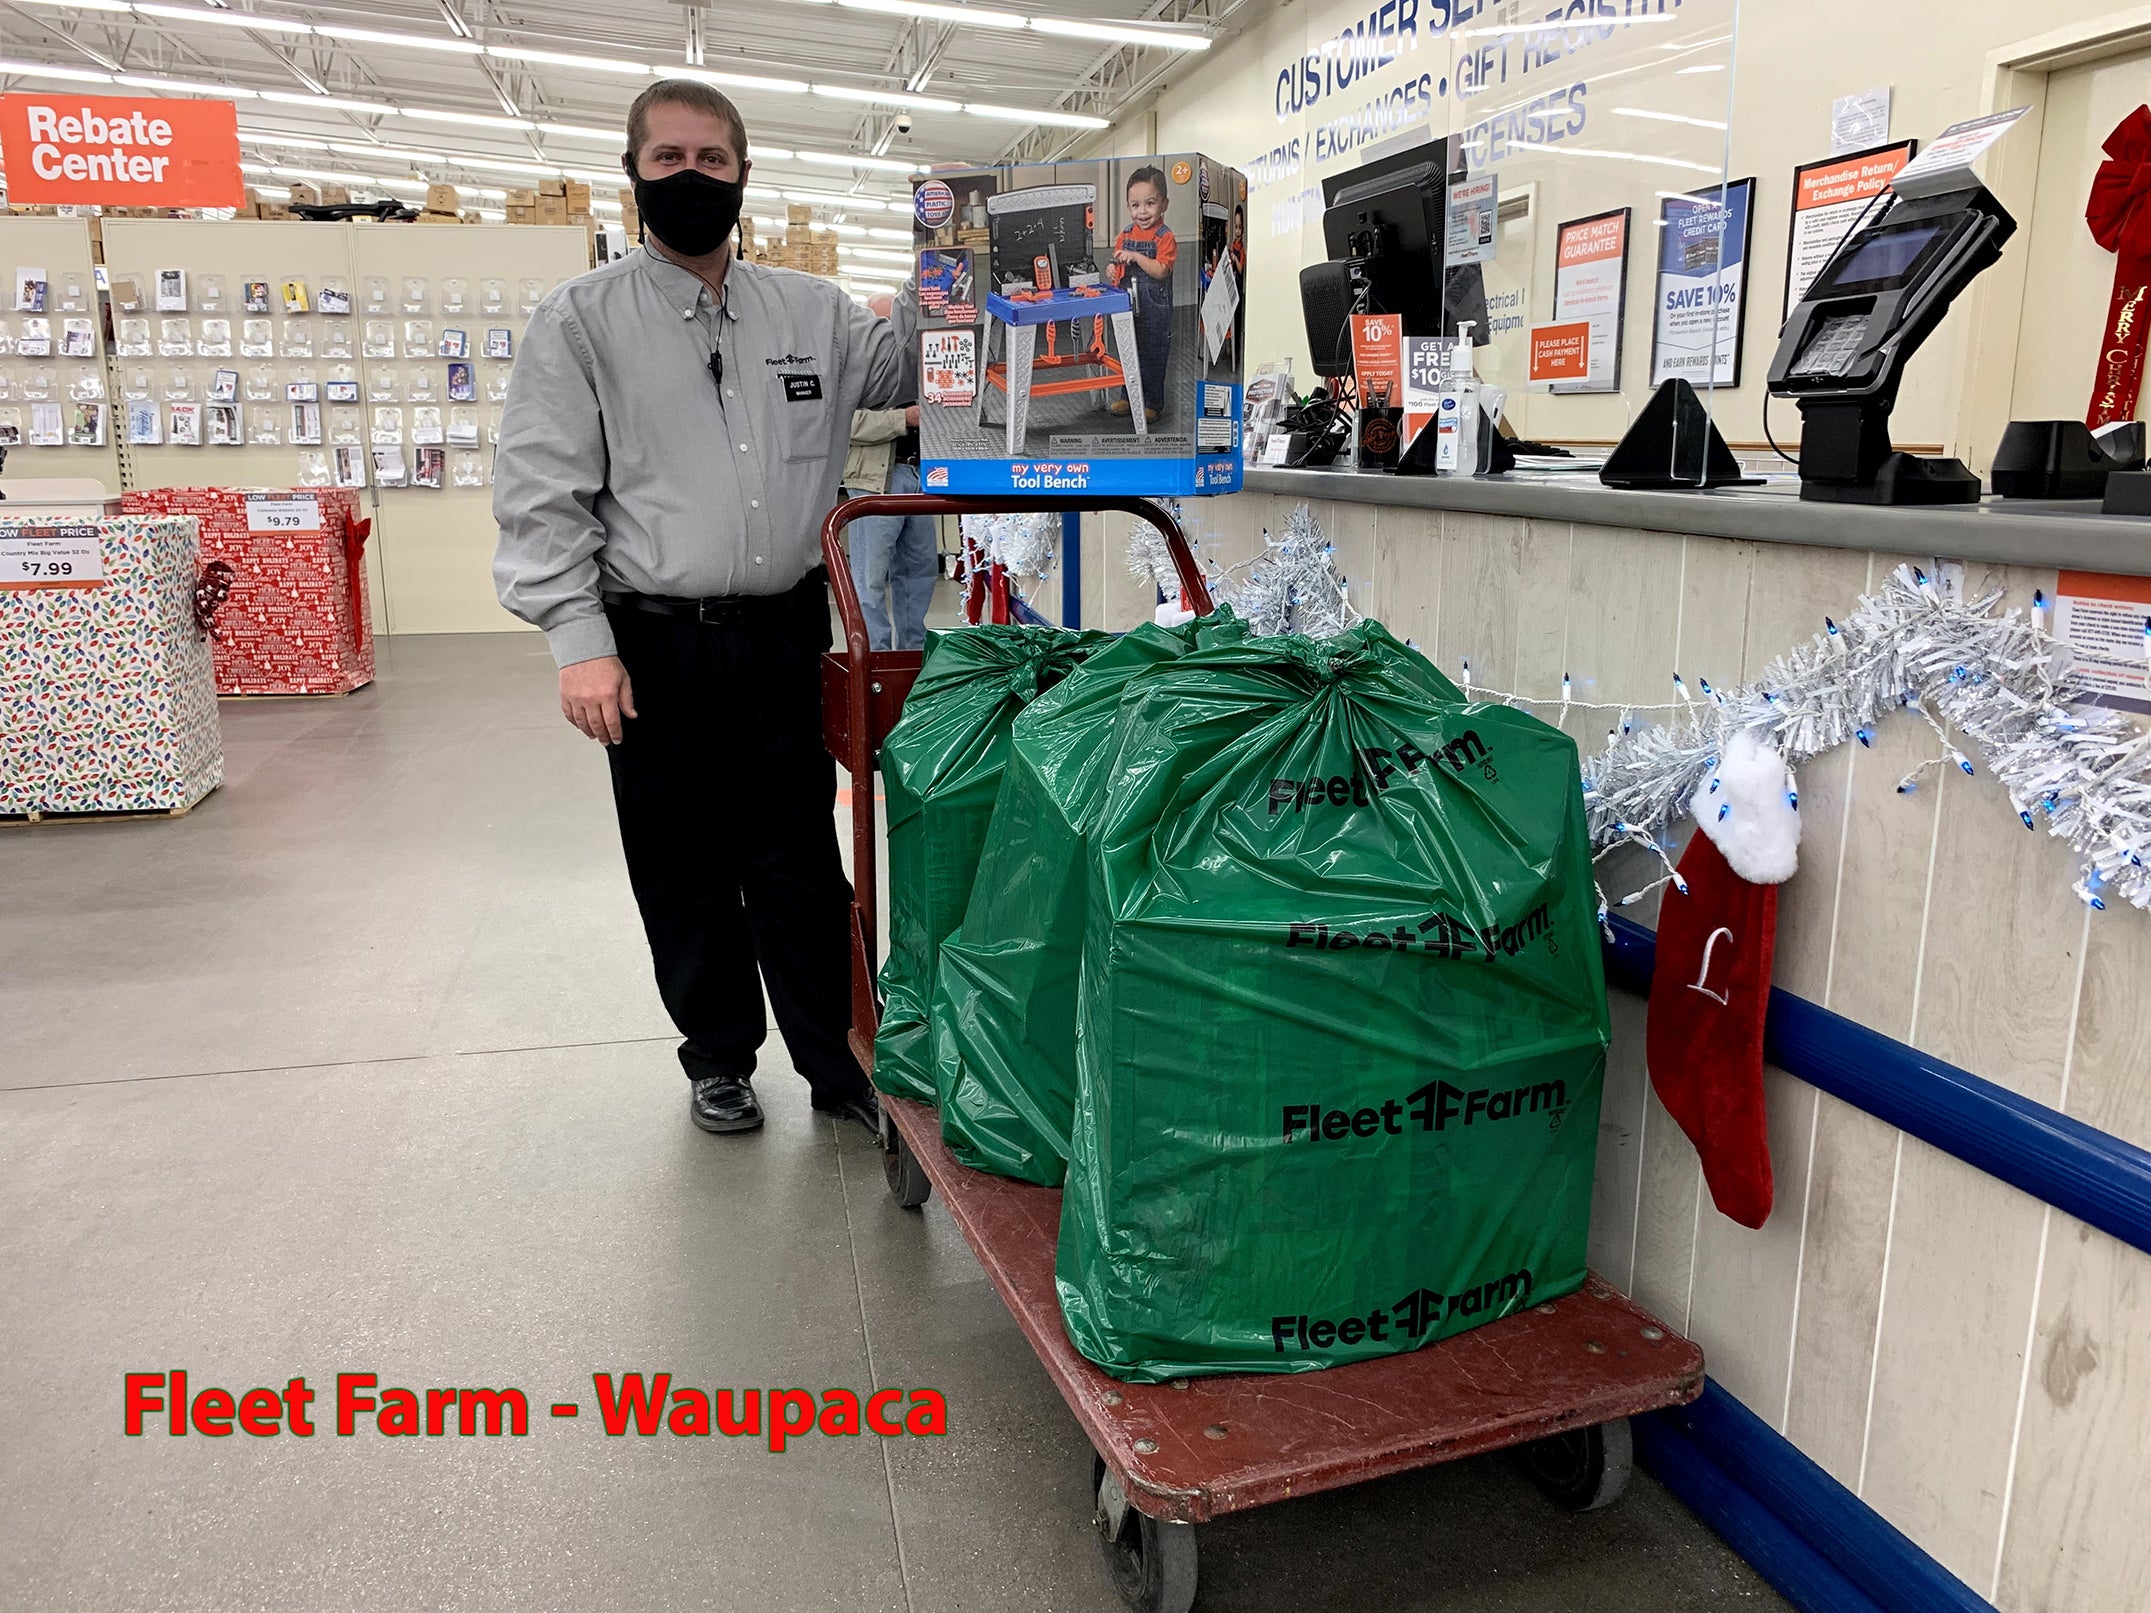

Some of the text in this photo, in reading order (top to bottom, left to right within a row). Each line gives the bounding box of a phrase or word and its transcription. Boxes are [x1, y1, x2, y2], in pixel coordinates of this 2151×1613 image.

[1275, 0, 1419, 124] CUSTOMER
[1455, 32, 1515, 101] GIFT
[27, 106, 172, 146] Rebate
[1240, 137, 1300, 193] ETURNS
[1316, 73, 1432, 163] EXCHANGES
[1464, 81, 1587, 167] ICENSES
[32, 143, 169, 182] Center
[1176, 165, 1189, 176] 2+
[1804, 159, 1898, 190] Merchandise Return/
[1812, 178, 1886, 201] Exchange Policy
[1566, 221, 1619, 243] PRICE MATCH
[1678, 215, 1697, 228] FLEET
[1683, 225, 1706, 237] CREDIT
[1564, 237, 1616, 259] GUARANTEE
[1485, 289, 1518, 310] ectrical
[1666, 283, 1736, 310] SAVE 10%
[1363, 325, 1393, 342] 10%
[1488, 313, 1524, 335] Equipm
[1421, 342, 1442, 351] GET
[1539, 337, 1579, 348] PLEASE PLACE
[1539, 347, 1579, 358] CASH PAYMENT
[1413, 352, 1450, 366] FRE
[1551, 358, 1566, 366] HERE
[1411, 368, 1440, 386] $10
[928, 392, 942, 404] 34
[1012, 464, 1089, 475] my very own
[1011, 474, 1087, 489] Tool Bench
[267, 516, 300, 527] $9.79
[0, 528, 94, 537] OW FLEET PRICE
[22, 561, 72, 576] $7.99
[1267, 770, 1369, 815] Fleet
[1480, 903, 1549, 963] Farm
[1687, 927, 1734, 1006] L
[1282, 1079, 1566, 1144] Fleet Farm
[1271, 1309, 1388, 1352] Fleet
